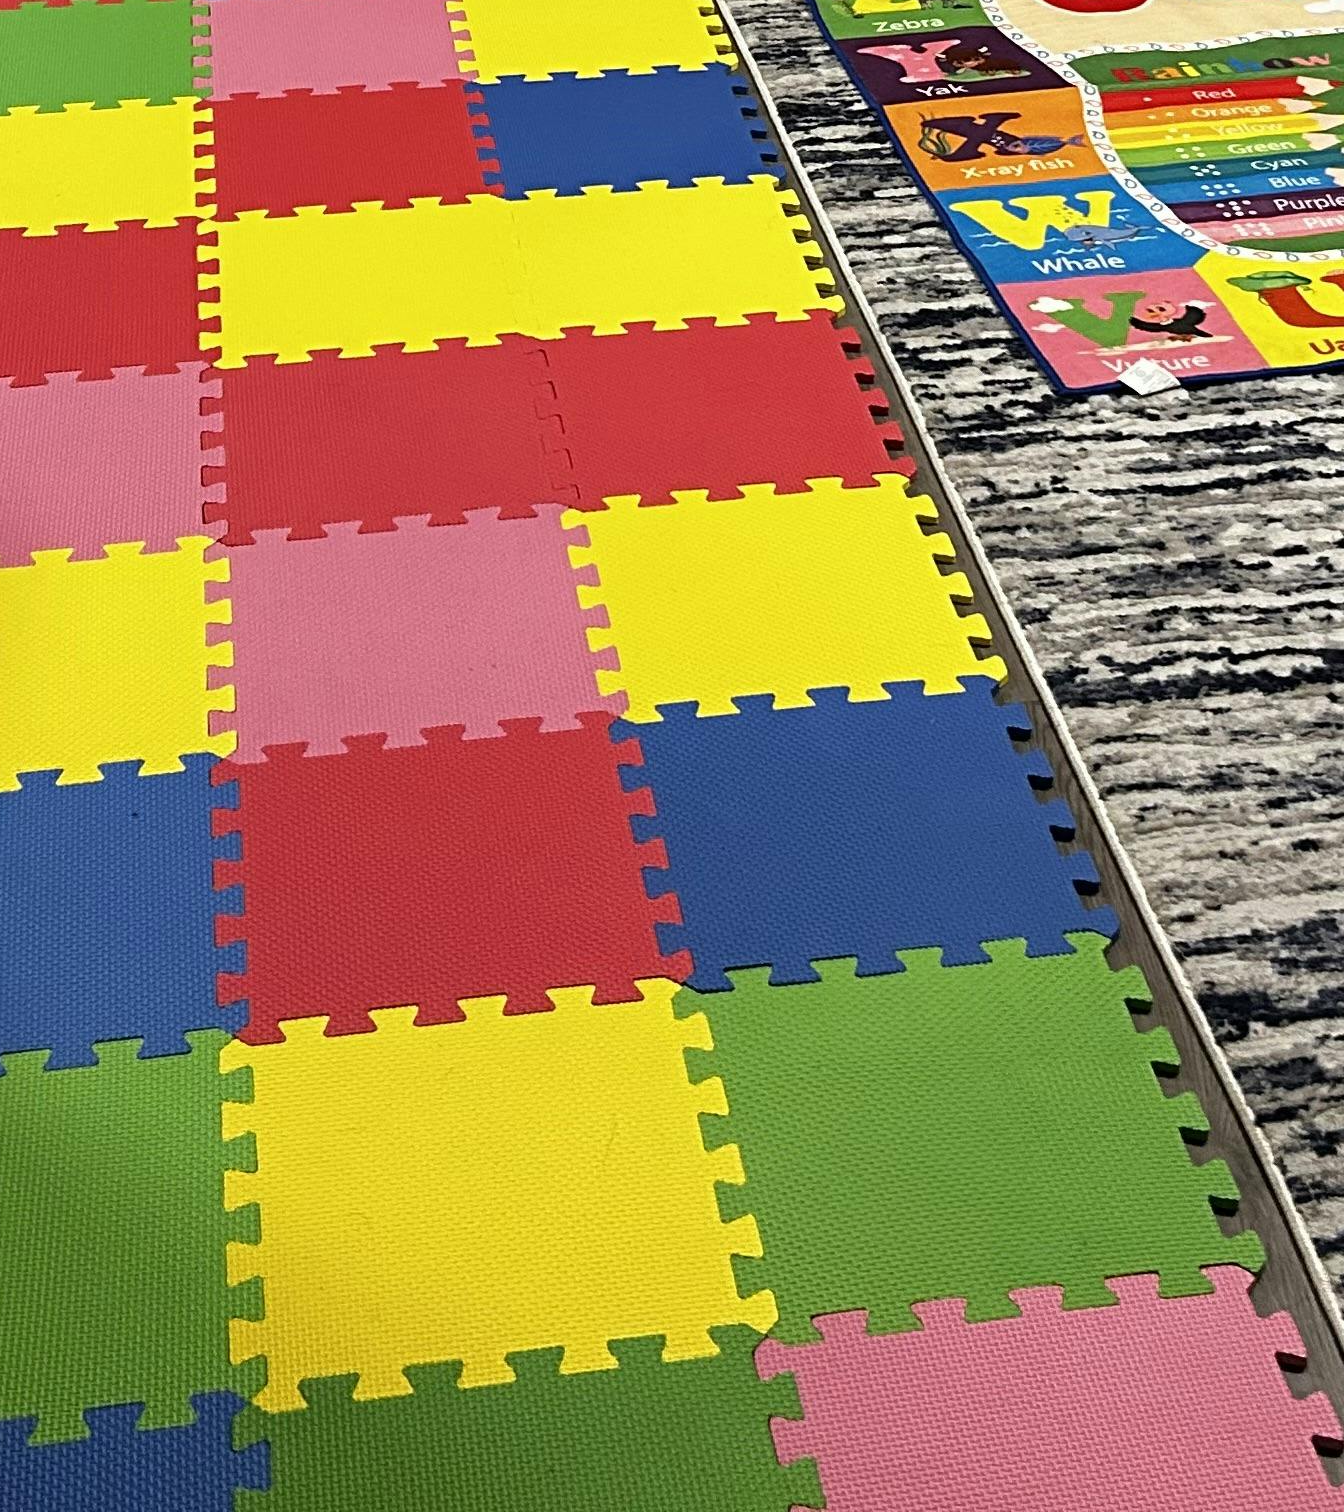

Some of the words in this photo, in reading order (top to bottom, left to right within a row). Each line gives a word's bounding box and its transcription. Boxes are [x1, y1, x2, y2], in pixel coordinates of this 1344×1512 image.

[872, 17, 945, 33] Zebra
[857, 39, 961, 84] Y
[1110, 53, 1331, 83] Rainbow
[915, 84, 969, 98] Yak
[1192, 88, 1237, 100] Red
[1191, 104, 1273, 118] Orange
[921, 112, 1026, 163] X
[1209, 122, 1285, 137] Yellow
[1227, 140, 1297, 155] Green
[960, 164, 1024, 181] X-ray
[1028, 158, 1076, 172] fish
[1250, 157, 1309, 172] Cyan
[1267, 175, 1321, 189] Blue
[949, 190, 1116, 251] W
[1032, 254, 1126, 275] Whale
[1048, 291, 1147, 349] V
[1101, 355, 1211, 373] Vure
